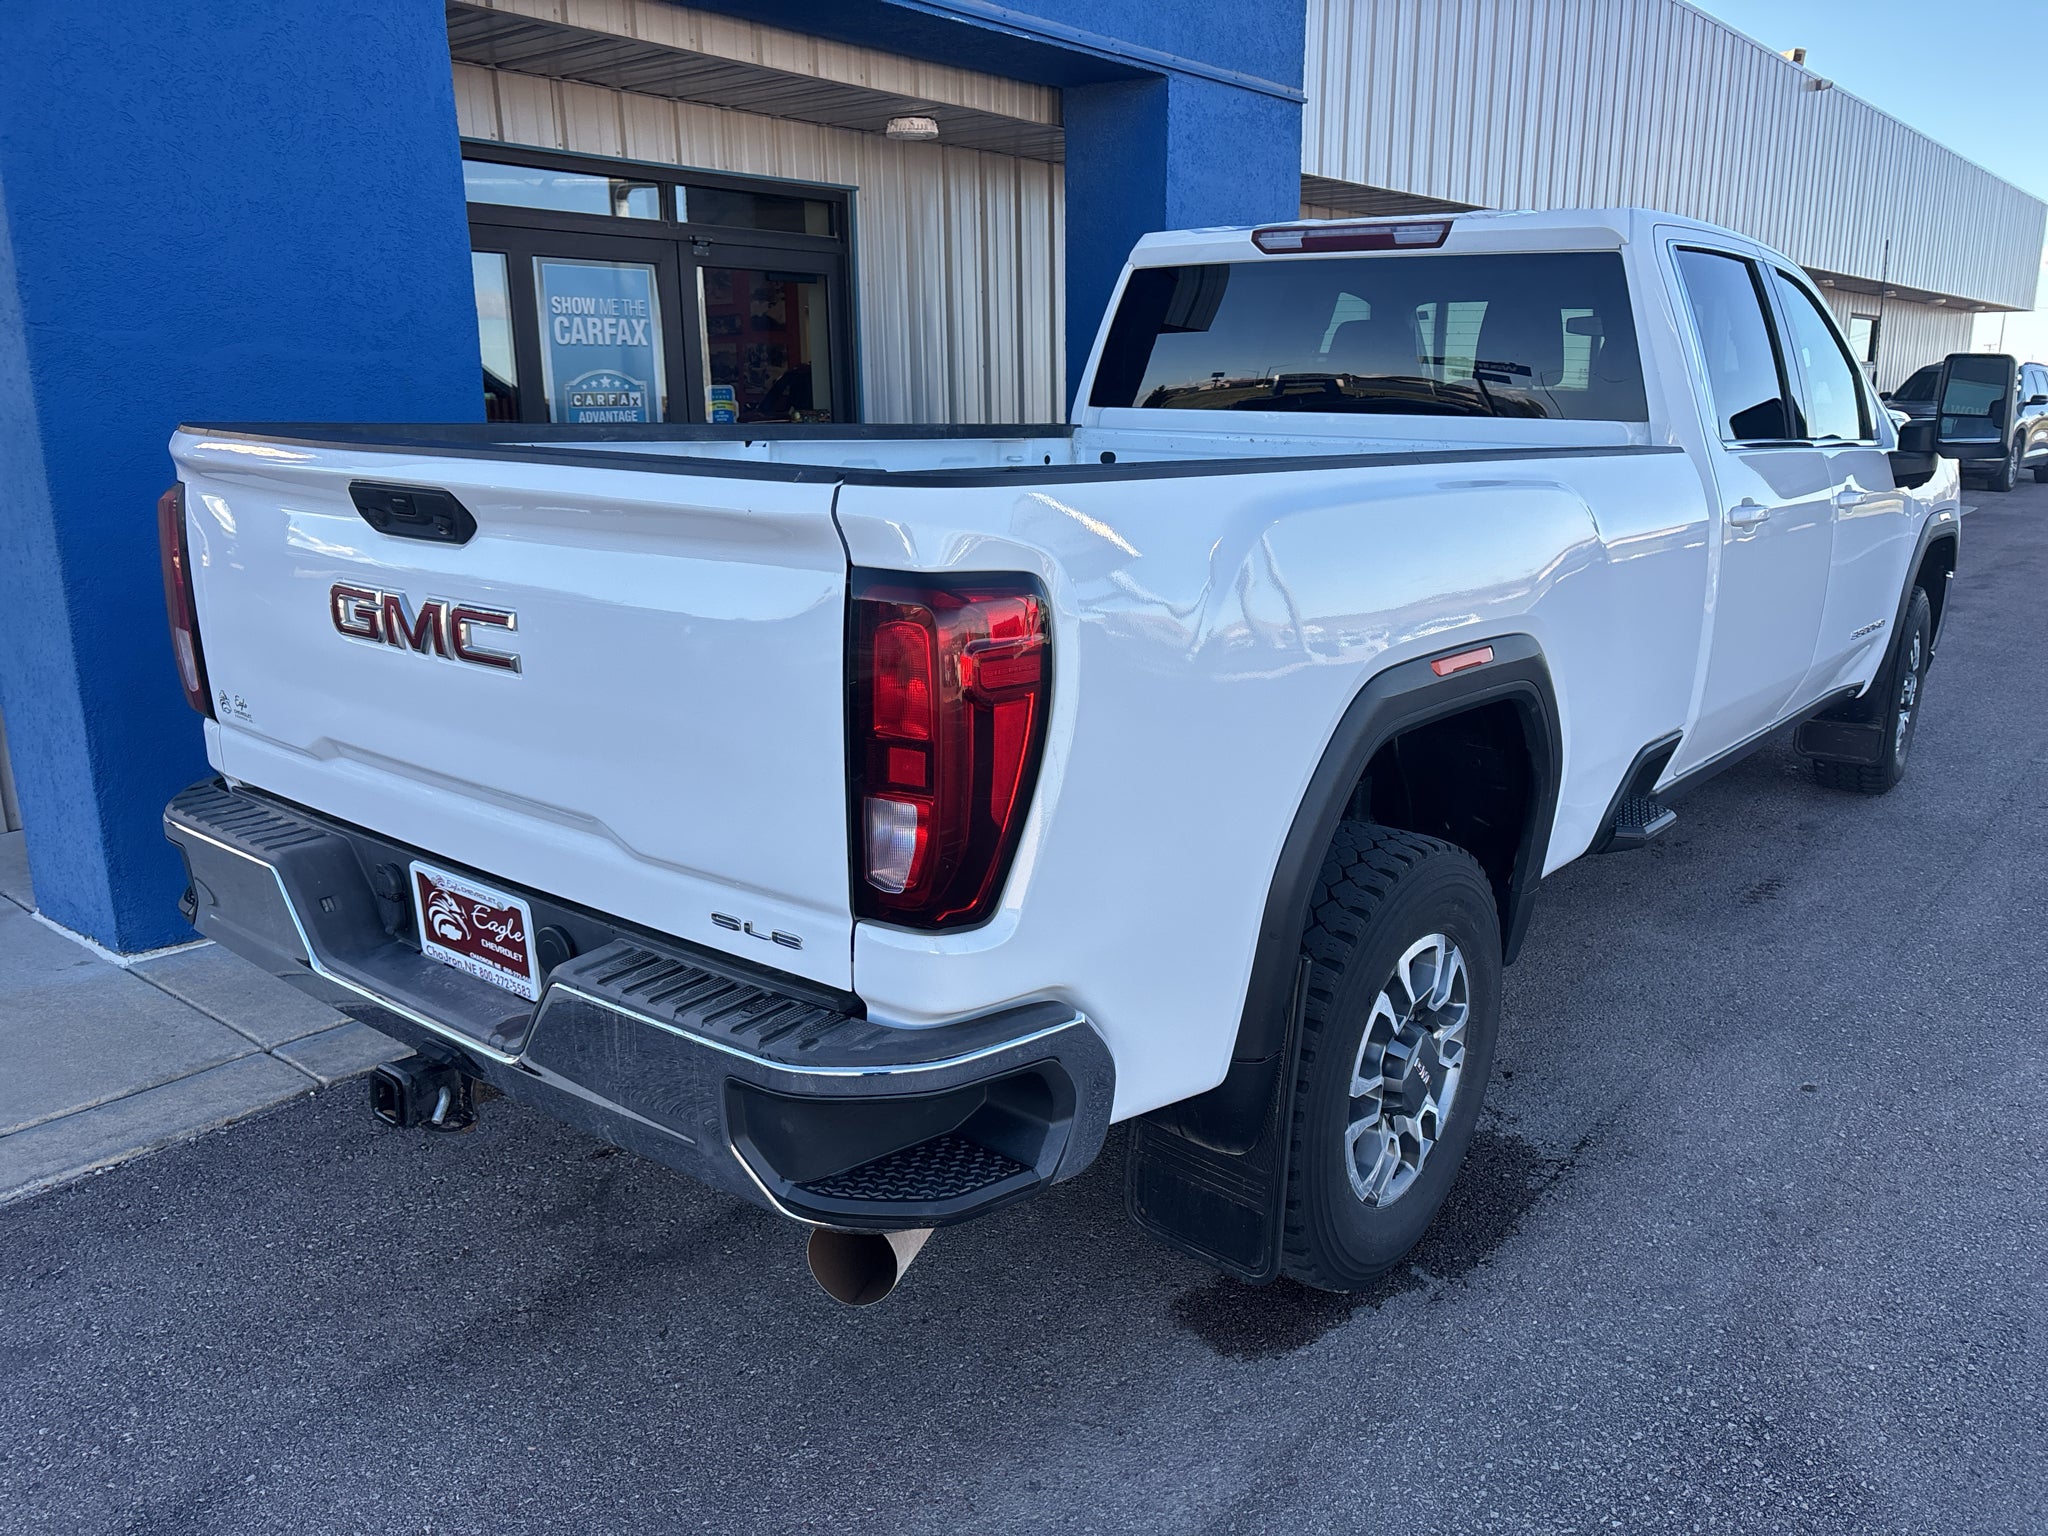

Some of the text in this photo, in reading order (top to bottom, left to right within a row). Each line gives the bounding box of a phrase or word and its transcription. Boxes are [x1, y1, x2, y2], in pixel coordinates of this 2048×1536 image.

[551, 296, 646, 317] SHOW ME THE
[554, 316, 648, 347] CARFAX
[572, 394, 641, 407] CARFAX
[579, 410, 638, 423] ADVANTAGE
[329, 578, 523, 675] GMC
[471, 904, 525, 942] Eagle
[710, 911, 804, 951] SLE
[480, 938, 524, 963] CHEVROLET
